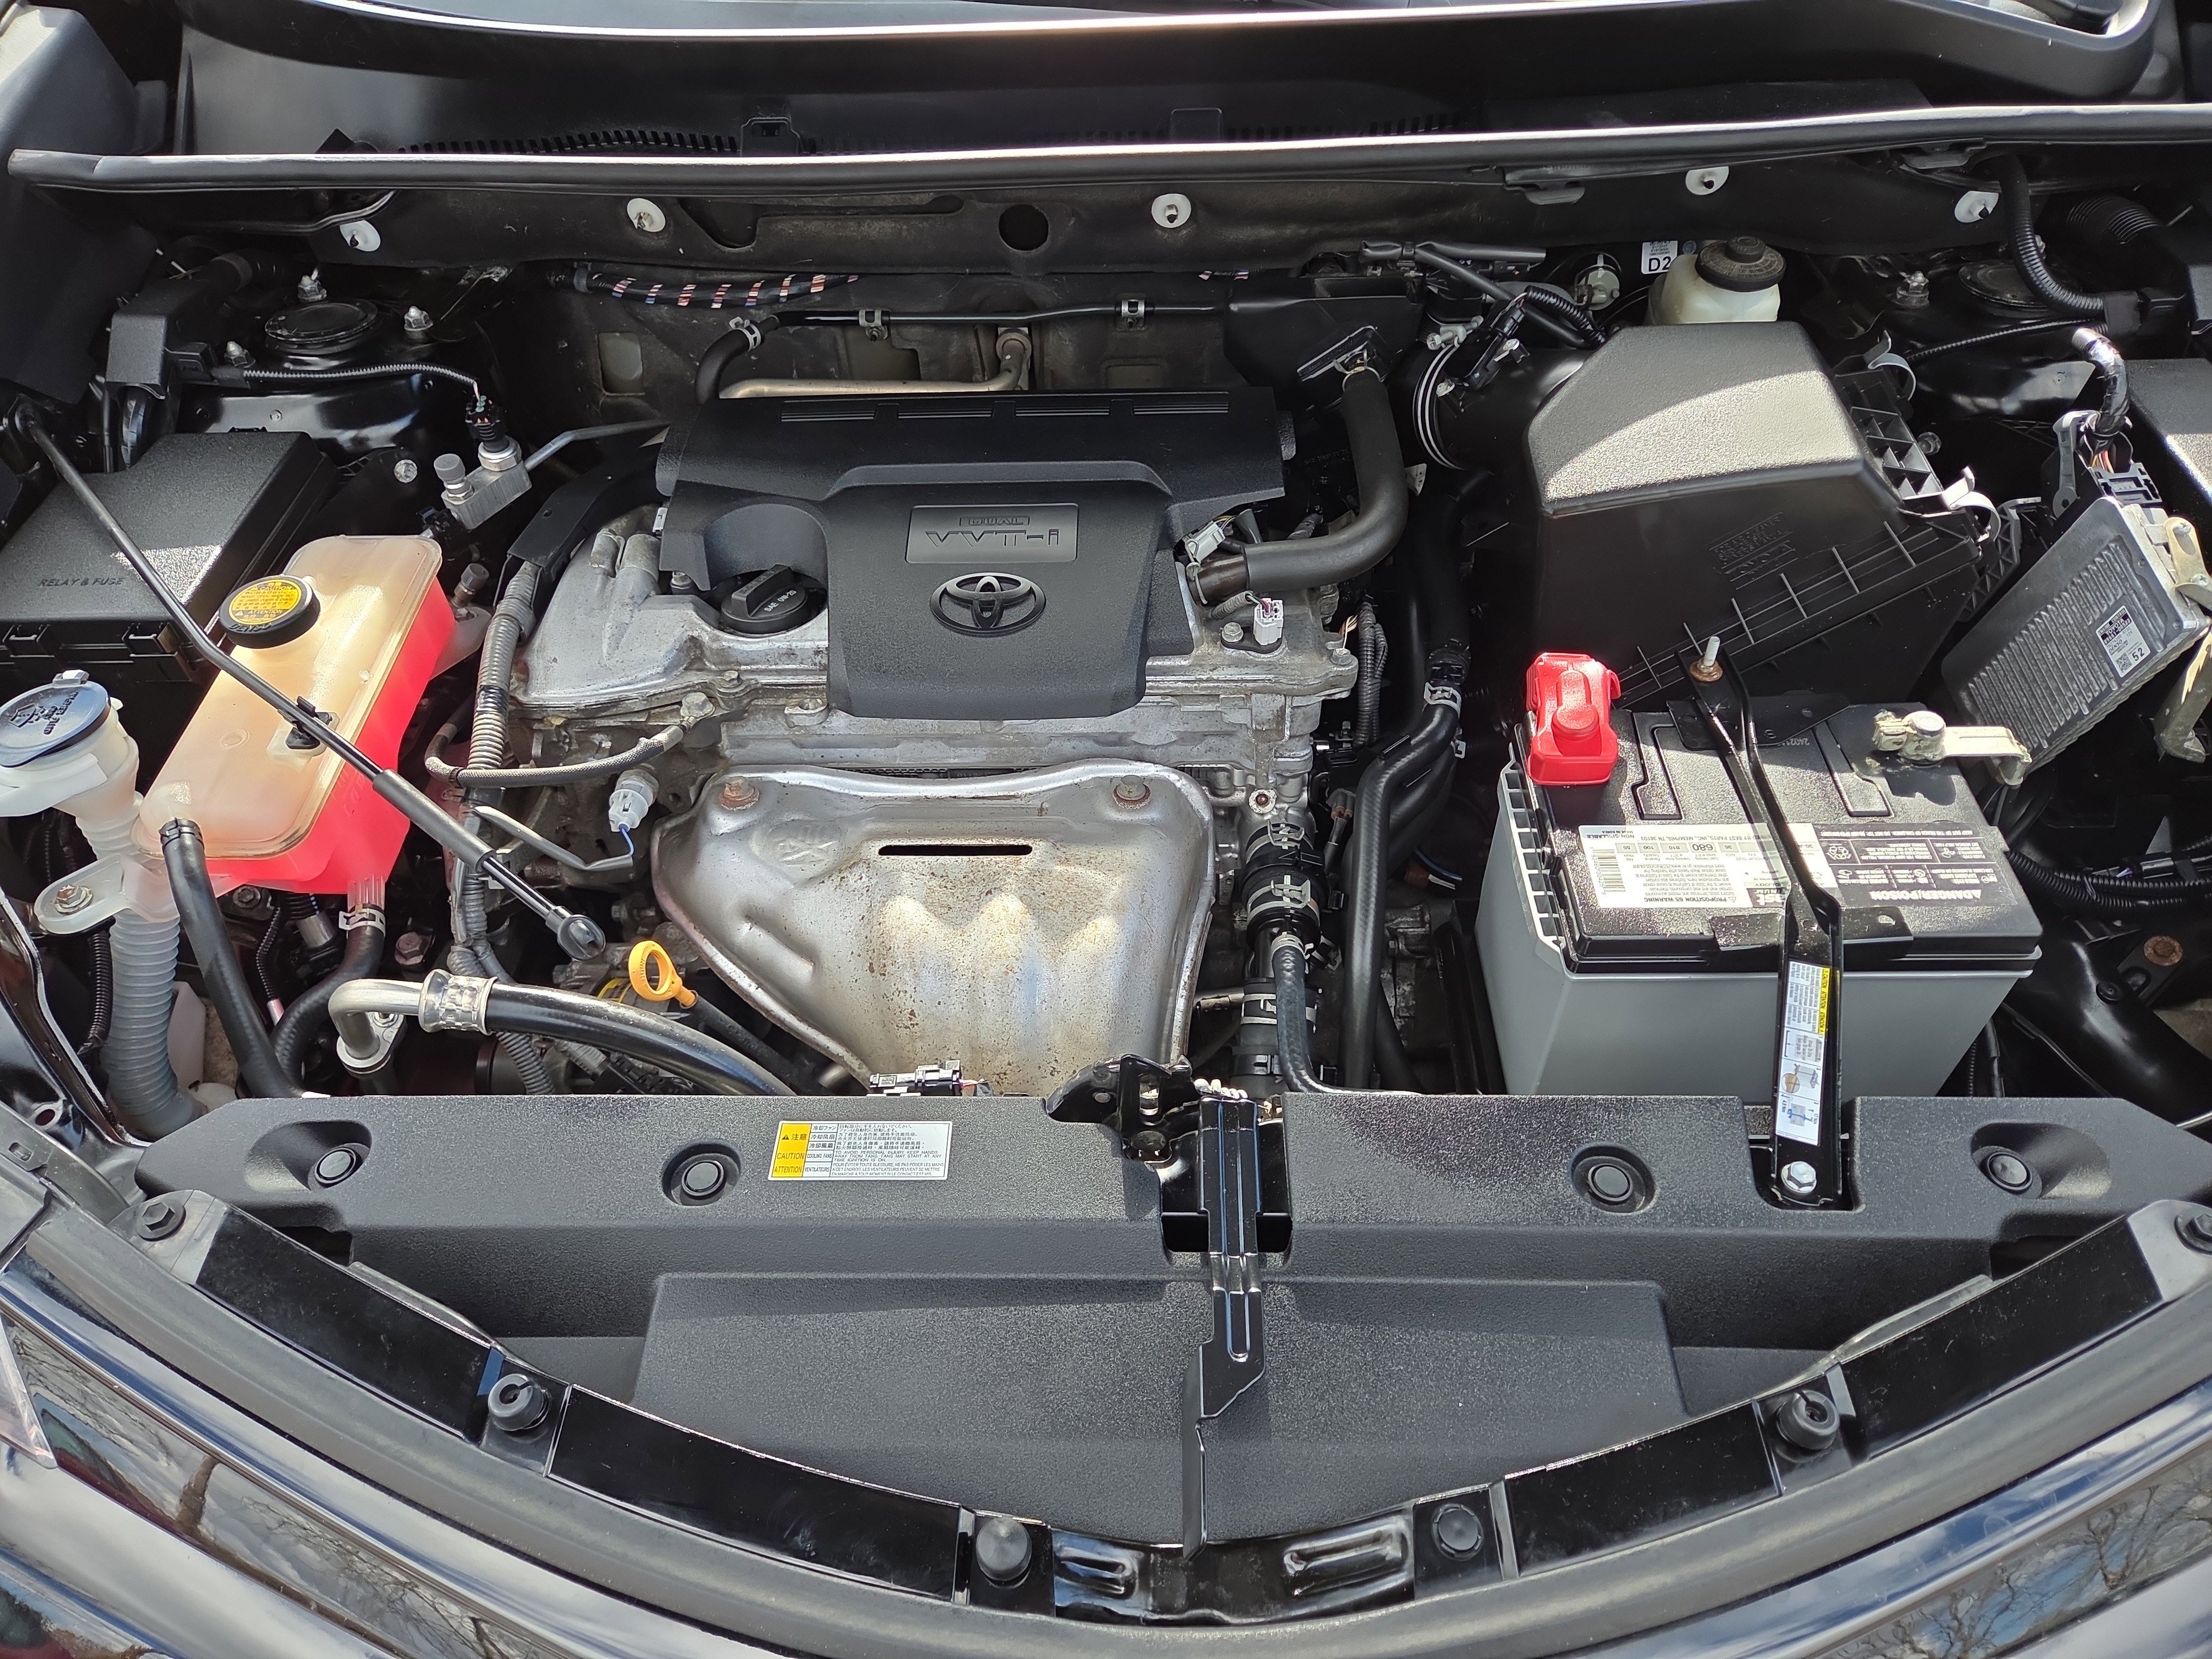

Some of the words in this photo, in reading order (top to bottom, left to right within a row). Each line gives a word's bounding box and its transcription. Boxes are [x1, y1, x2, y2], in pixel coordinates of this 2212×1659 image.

[1648, 256, 1671, 271] D2
[925, 529, 1059, 547] VVT-i
[38, 578, 80, 586] RELAY
[92, 577, 125, 586] FUSE
[763, 601, 779, 612] SAE
[228, 623, 272, 632] DENSO
[2106, 618, 2124, 635] TOYOTA
[2132, 647, 2144, 661] 52
[1868, 890, 1973, 899] DANGER/POISON
